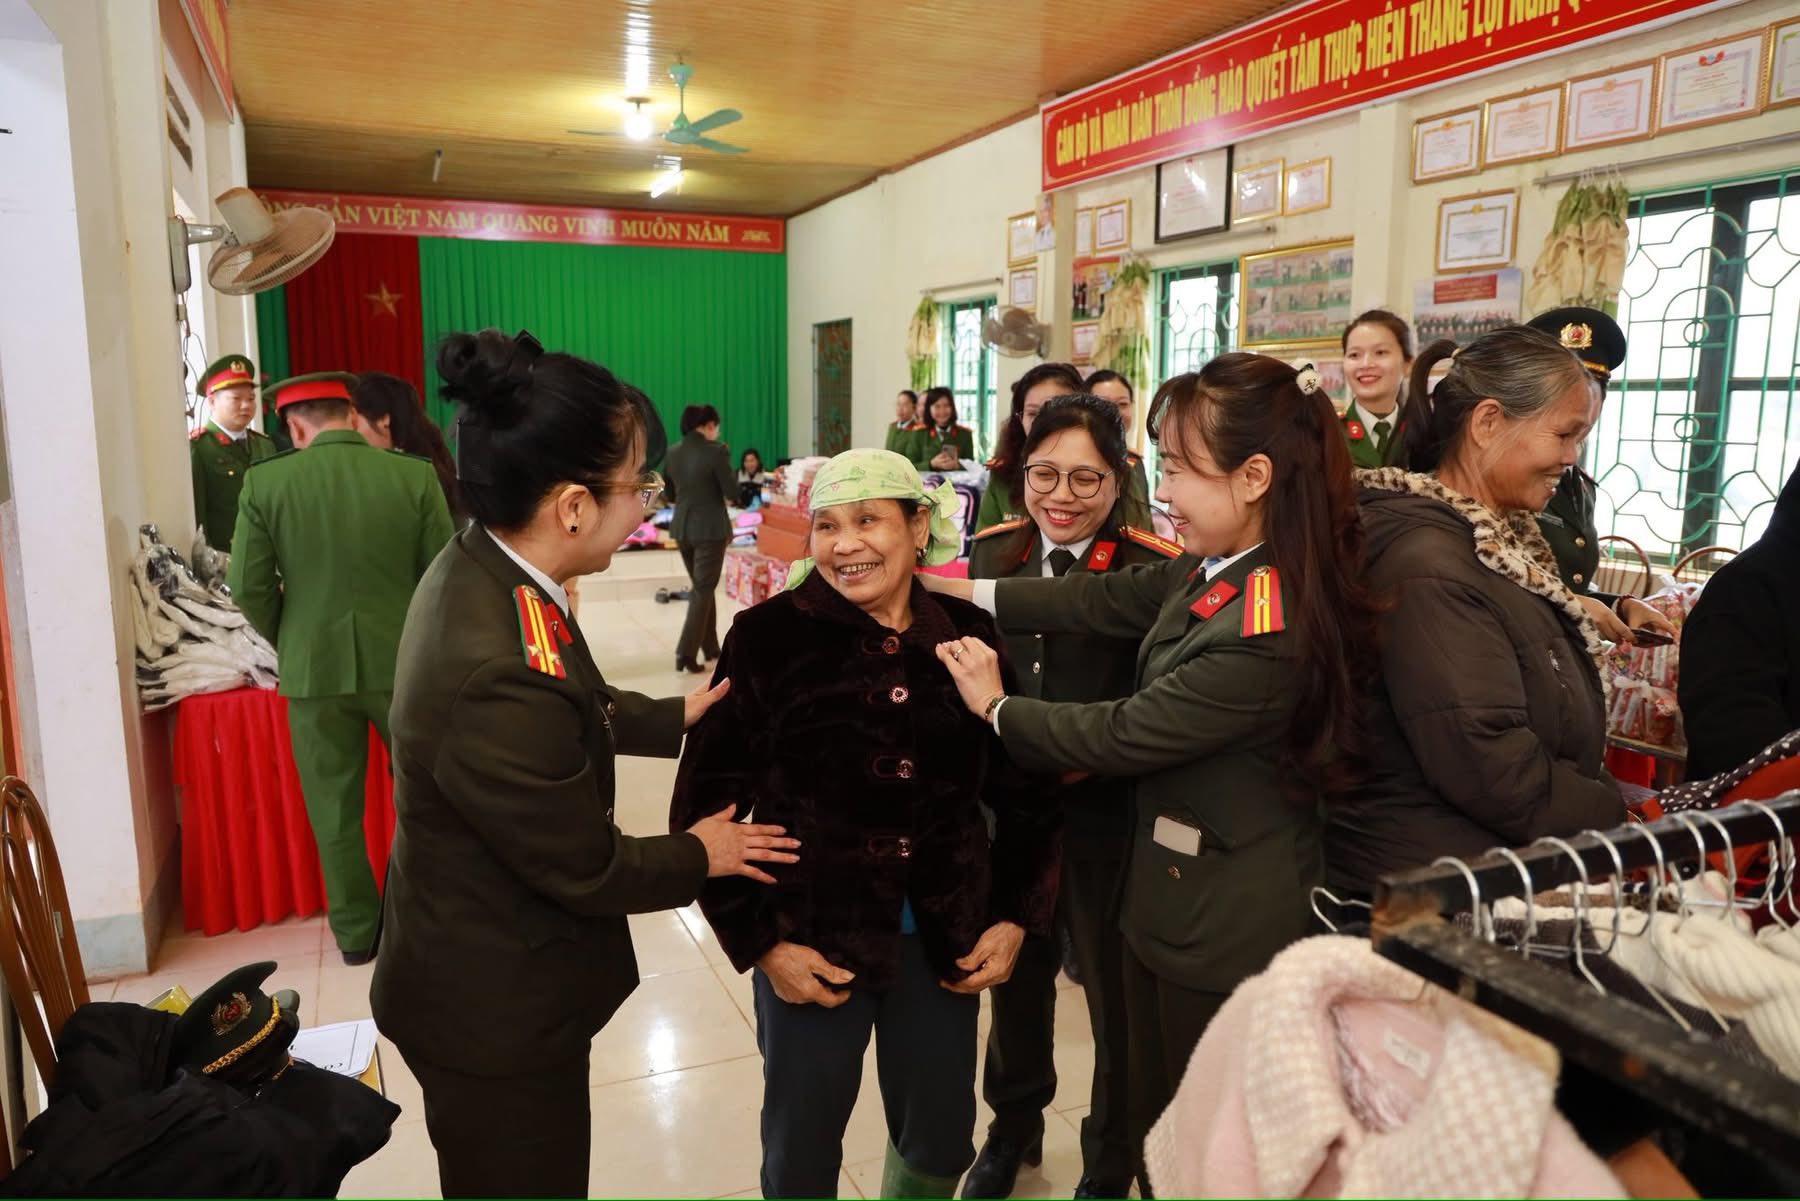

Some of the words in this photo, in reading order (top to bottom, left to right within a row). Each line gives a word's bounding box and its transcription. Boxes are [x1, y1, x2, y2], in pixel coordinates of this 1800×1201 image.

[1056, 120, 1075, 167] CÁN
[1075, 112, 1089, 167] BỘ
[1089, 107, 1101, 156] VÀ
[1102, 98, 1130, 152] NHÂN
[1131, 90, 1153, 144] DÂN
[1154, 79, 1183, 137] THÔN
[1246, 33, 1288, 113] QUYẾT
[1290, 31, 1321, 94] TÂM
[1323, 19, 1363, 89] THỰC
[1365, 0, 1406, 78] HIỆN
[367, 203, 421, 231] VIỆT
[426, 209, 476, 229] NAM
[482, 212, 560, 233] QUANG
[563, 216, 616, 236] VINH
[621, 216, 682, 240] MUÔN
[685, 220, 731, 243] NĂM
